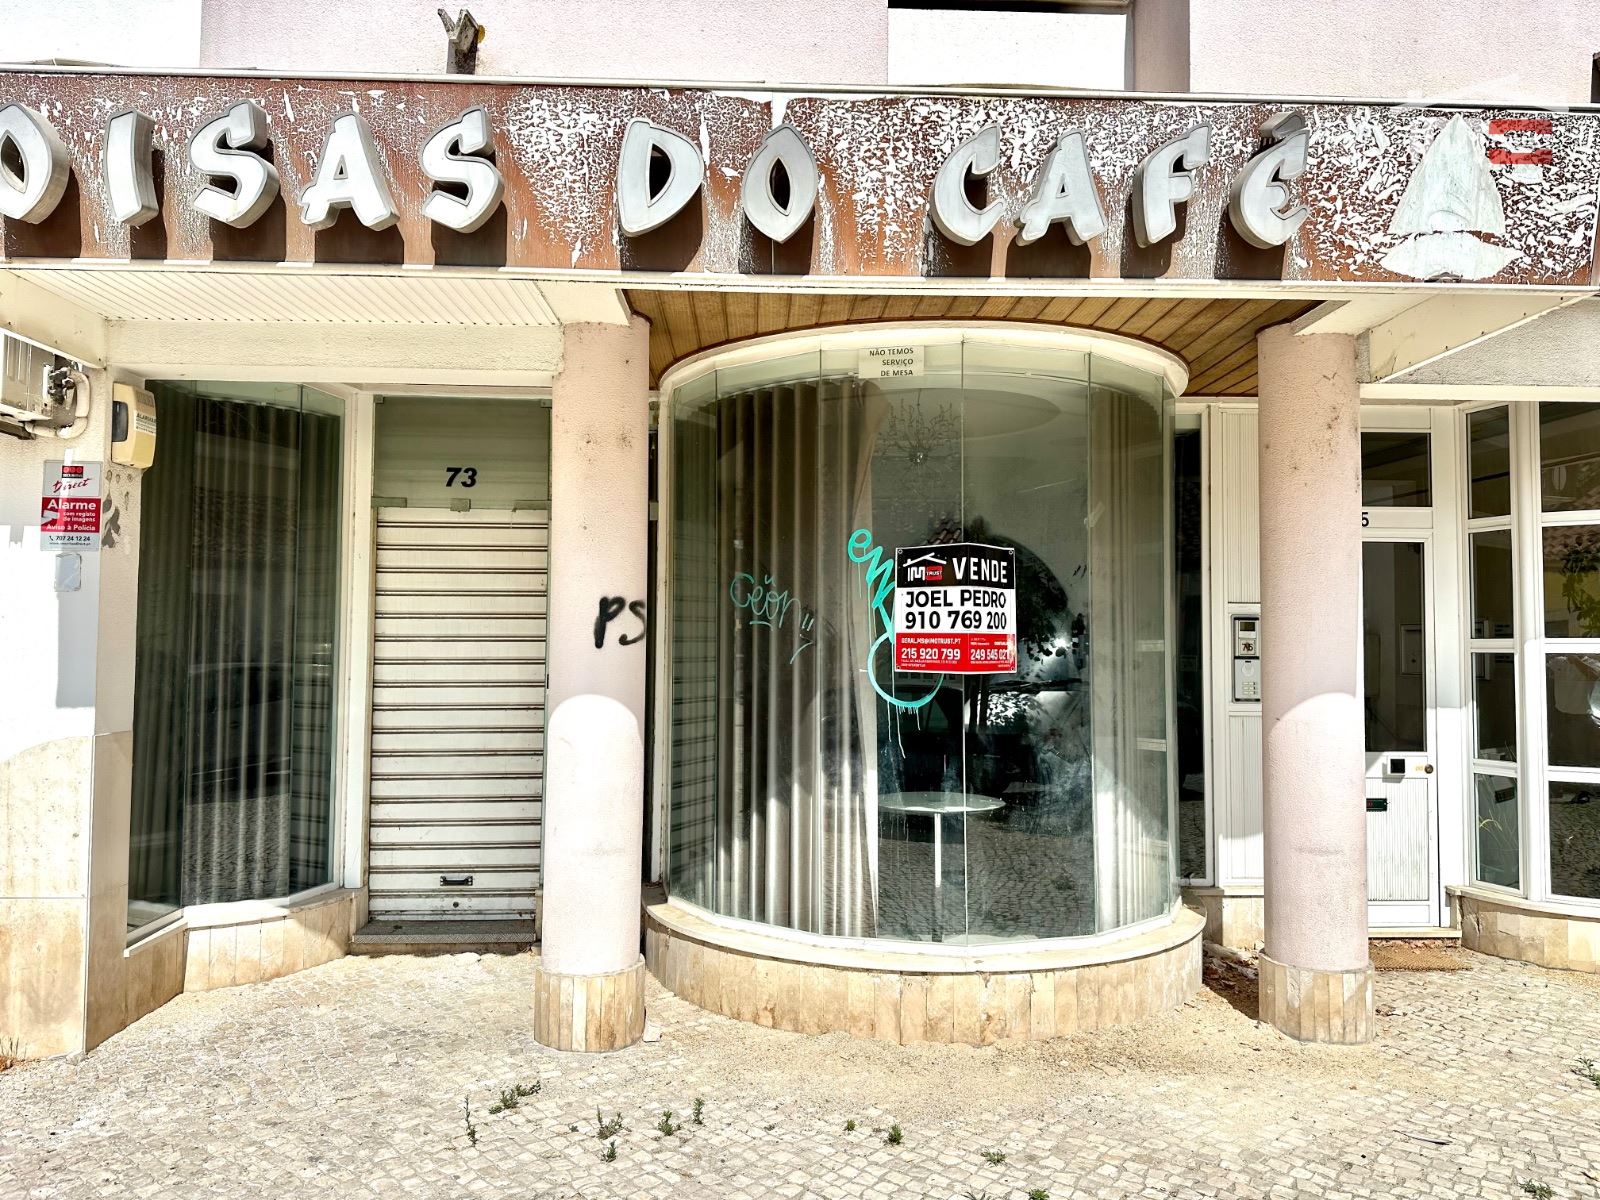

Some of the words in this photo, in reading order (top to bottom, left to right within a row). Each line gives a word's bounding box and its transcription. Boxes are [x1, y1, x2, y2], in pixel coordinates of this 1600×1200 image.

[616, 117, 820, 244] DO
[929, 111, 1312, 250] CAFÉ
[869, 347, 886, 356] NÃO
[888, 347, 914, 355] TEMOS
[881, 358, 914, 367] SERVIÇO
[445, 467, 478, 488] 73
[47, 499, 96, 510] Alarme
[952, 557, 1008, 583] VENDE
[905, 590, 953, 608] JOEL
[960, 589, 1006, 608] PEDRO
[905, 611, 941, 629] 910
[947, 610, 982, 629] 769
[986, 611, 1007, 630] 200
[901, 648, 918, 659] 215
[920, 648, 939, 660] 920
[941, 648, 961, 660] 799
[970, 649, 985, 661] 249
[986, 649, 998, 661] 545
